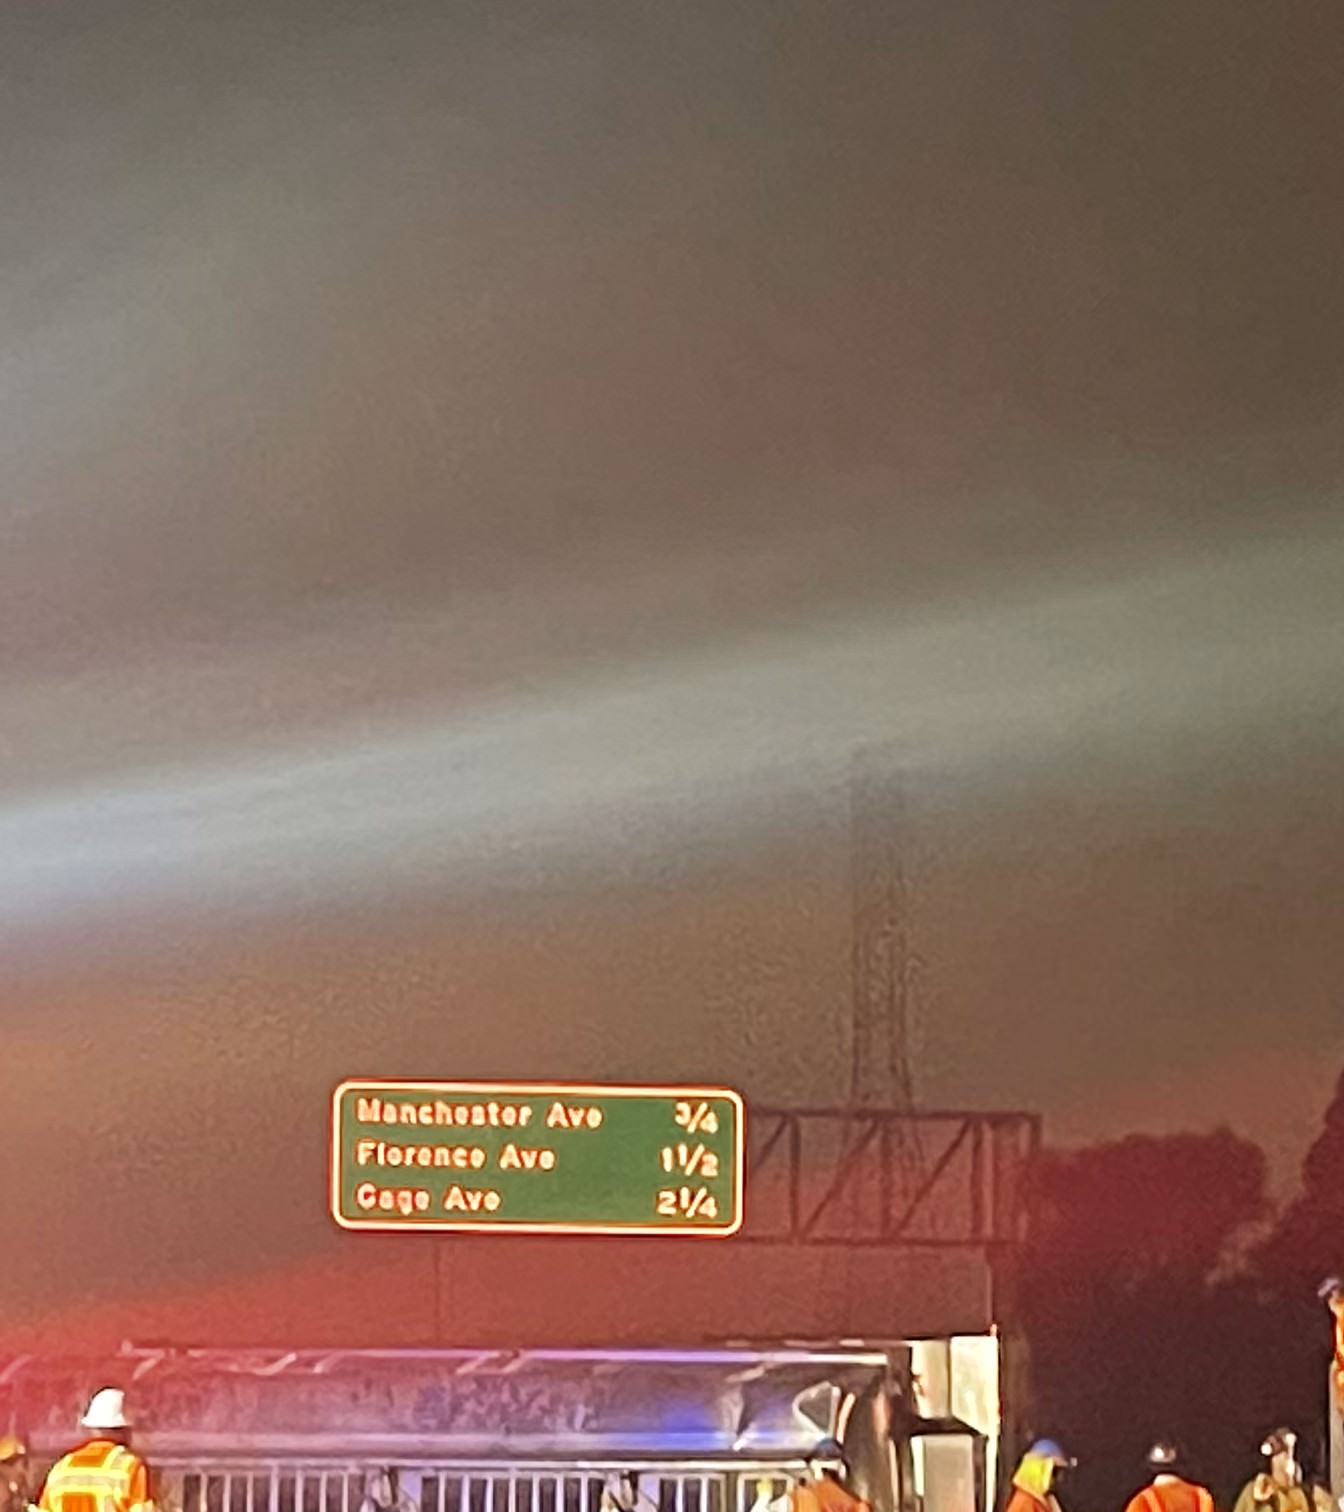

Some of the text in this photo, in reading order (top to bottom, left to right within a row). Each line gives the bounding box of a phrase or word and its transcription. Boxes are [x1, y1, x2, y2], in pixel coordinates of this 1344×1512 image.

[357, 1098, 532, 1127] Manchester
[546, 1102, 603, 1129] Ave
[357, 1141, 486, 1169] Florence
[499, 1144, 555, 1170] Ave
[357, 1183, 430, 1215] Gage
[444, 1185, 501, 1212] Ave
